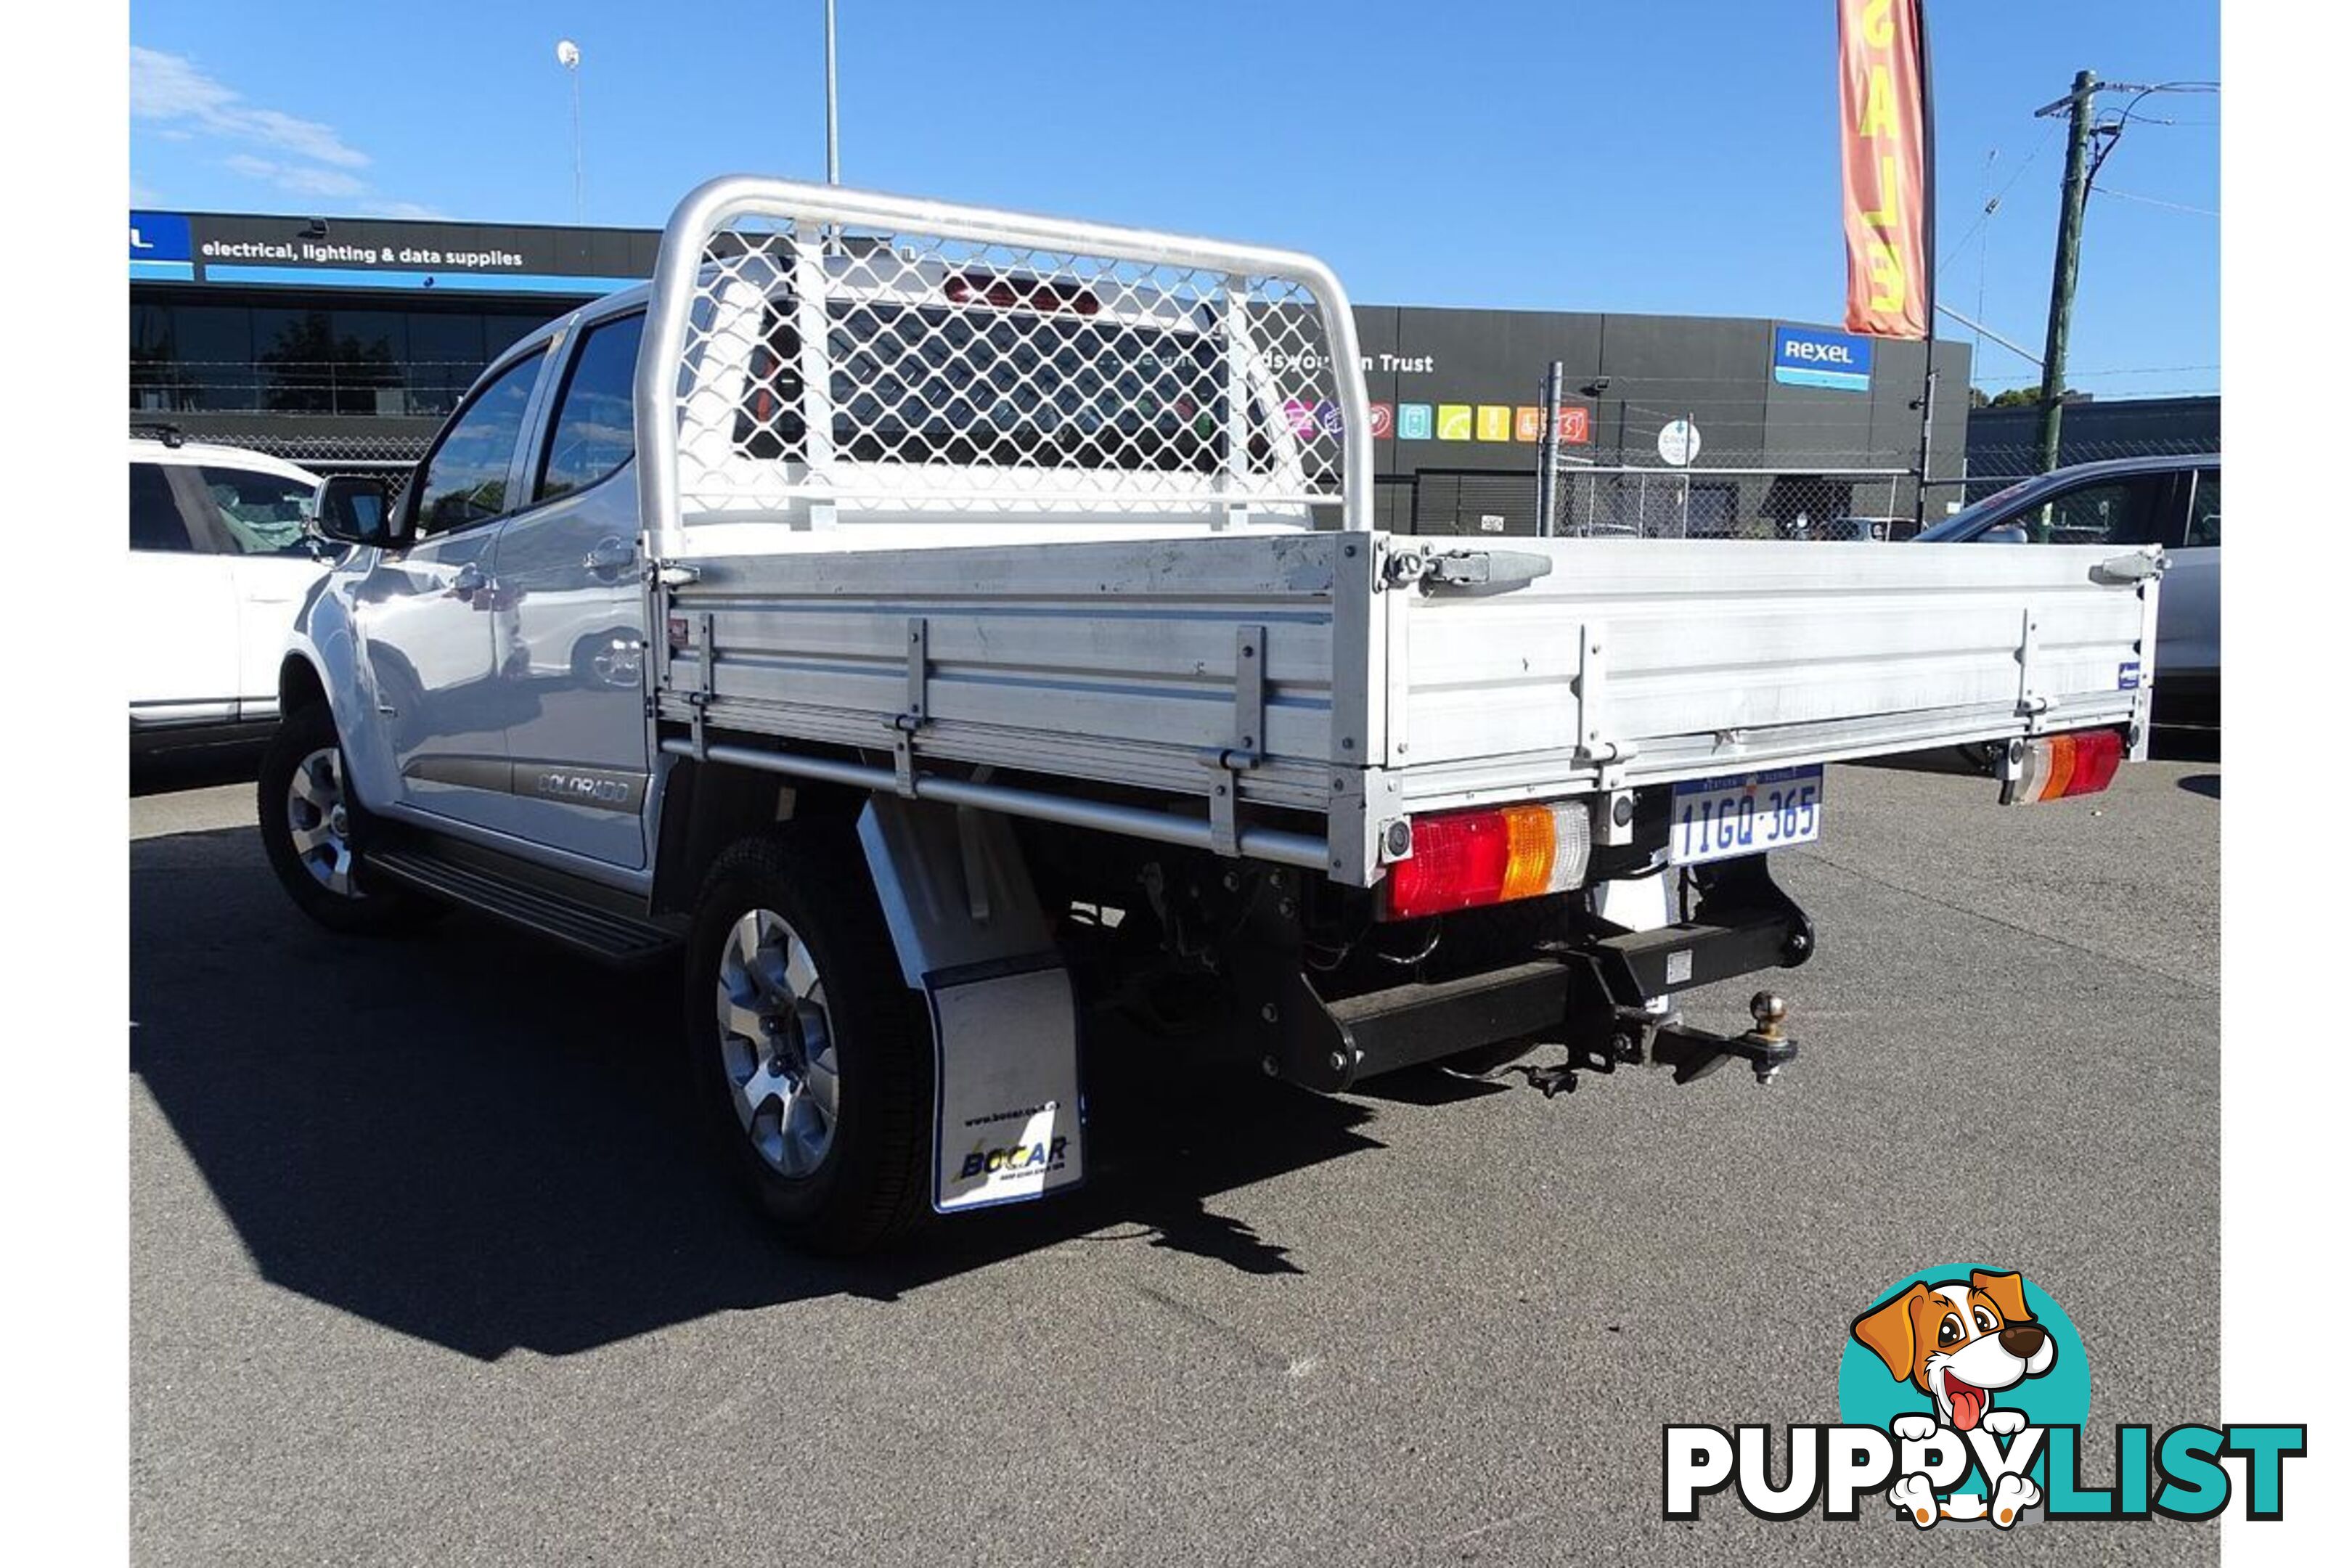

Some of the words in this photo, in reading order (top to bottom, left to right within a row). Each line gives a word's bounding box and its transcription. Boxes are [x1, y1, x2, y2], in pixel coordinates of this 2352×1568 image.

[202, 240, 298, 261] electrical,
[302, 244, 377, 264] lighting
[381, 248, 395, 262] &
[399, 248, 441, 264] data
[445, 250, 523, 267] supplies
[1379, 354, 1434, 372] Trust
[538, 773, 629, 802] COLORADO
[959, 1136, 1069, 1180] BOCAR
